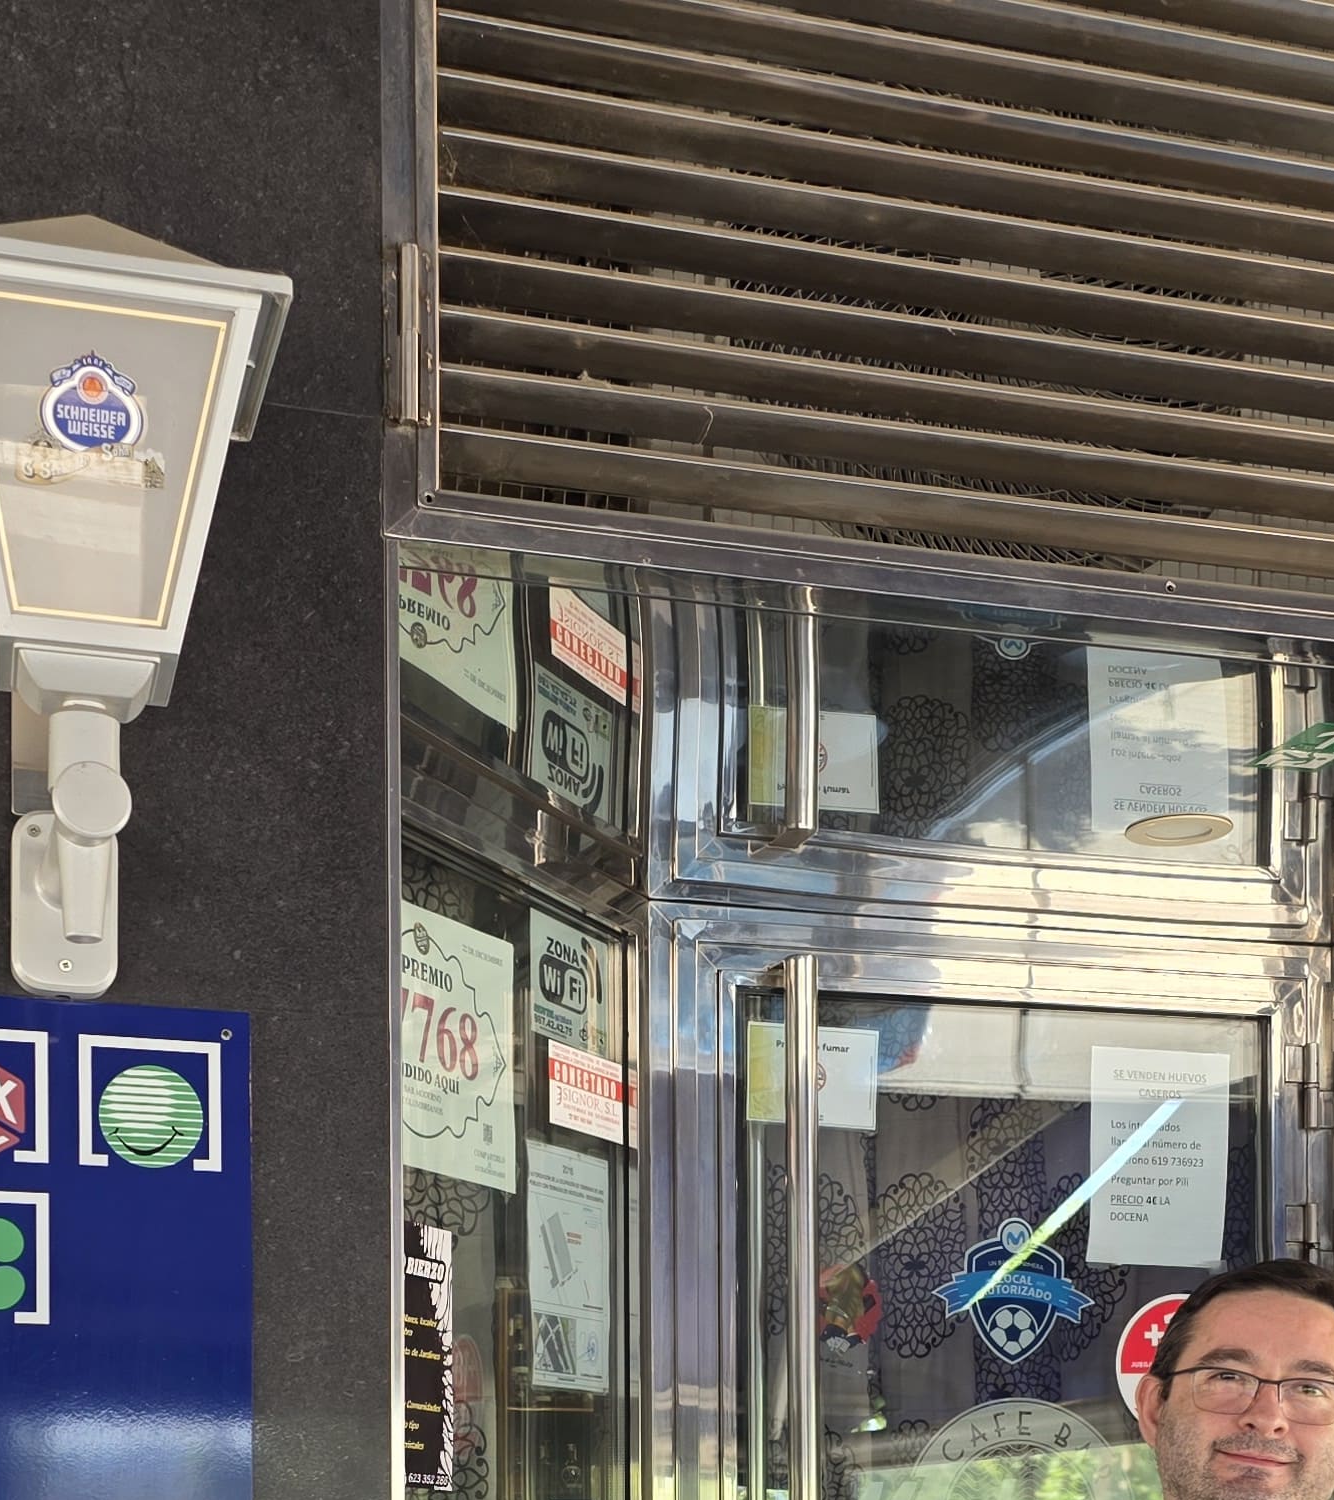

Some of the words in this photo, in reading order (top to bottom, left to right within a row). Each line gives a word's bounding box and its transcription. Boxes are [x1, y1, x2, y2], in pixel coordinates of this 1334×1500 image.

[57, 404, 126, 426] SCHNEIDER
[67, 420, 115, 439] WEISSE
[547, 936, 580, 967] ZONA
[402, 954, 453, 993] PREMIO
[823, 1043, 850, 1053] fumar
[402, 1062, 432, 1085] DIDO
[434, 1071, 460, 1095] AQUÍ
[554, 1060, 616, 1100] CONECTADO
[1113, 1069, 1124, 1079] SE
[1127, 1070, 1166, 1082] VENDEN
[1168, 1073, 1207, 1084] HUEVOS
[1139, 1088, 1182, 1099] CASEROS
[1111, 1119, 1126, 1130] Los
[1152, 1140, 1188, 1150] número
[1190, 1141, 1201, 1150] de
[1151, 1156, 1168, 1166] 619
[1170, 1158, 1204, 1168] 736923
[1111, 1175, 1155, 1186] Preguntar
[1158, 1178, 1172, 1187] por
[1175, 1176, 1189, 1187] Pili
[1110, 1194, 1143, 1205] PRECIO
[1159, 1197, 1170, 1206] LA
[1110, 1211, 1149, 1222] DOCENA
[406, 1257, 444, 1281] BIERZO
[942, 1410, 1032, 1462] CAFE
